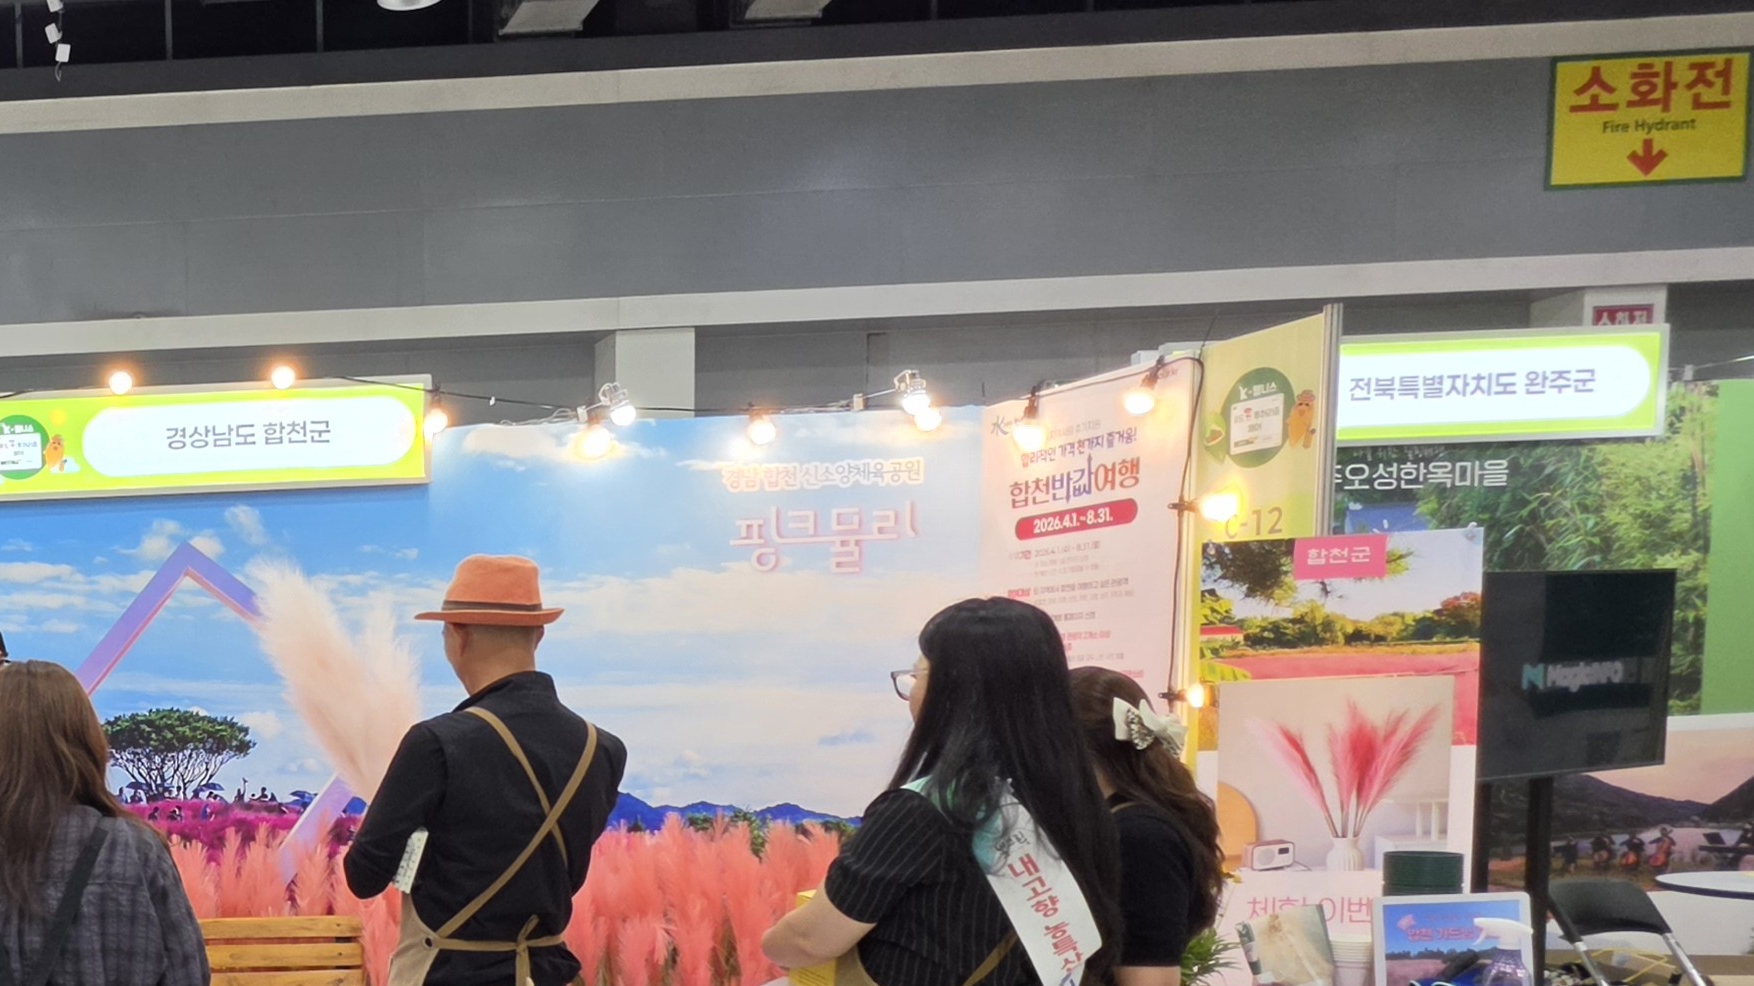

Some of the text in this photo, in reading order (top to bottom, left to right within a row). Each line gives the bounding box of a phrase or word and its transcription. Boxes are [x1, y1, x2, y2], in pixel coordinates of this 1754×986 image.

[1569, 58, 1734, 113] 소화전
[1602, 118, 1696, 135] Fire Hydrant
[1349, 369, 1596, 401] 전북특별자치도 완주군
[166, 420, 331, 450] 경상남도 합천군
[729, 500, 920, 573] 핑크뮬리
[1306, 546, 1371, 566] 합천군
